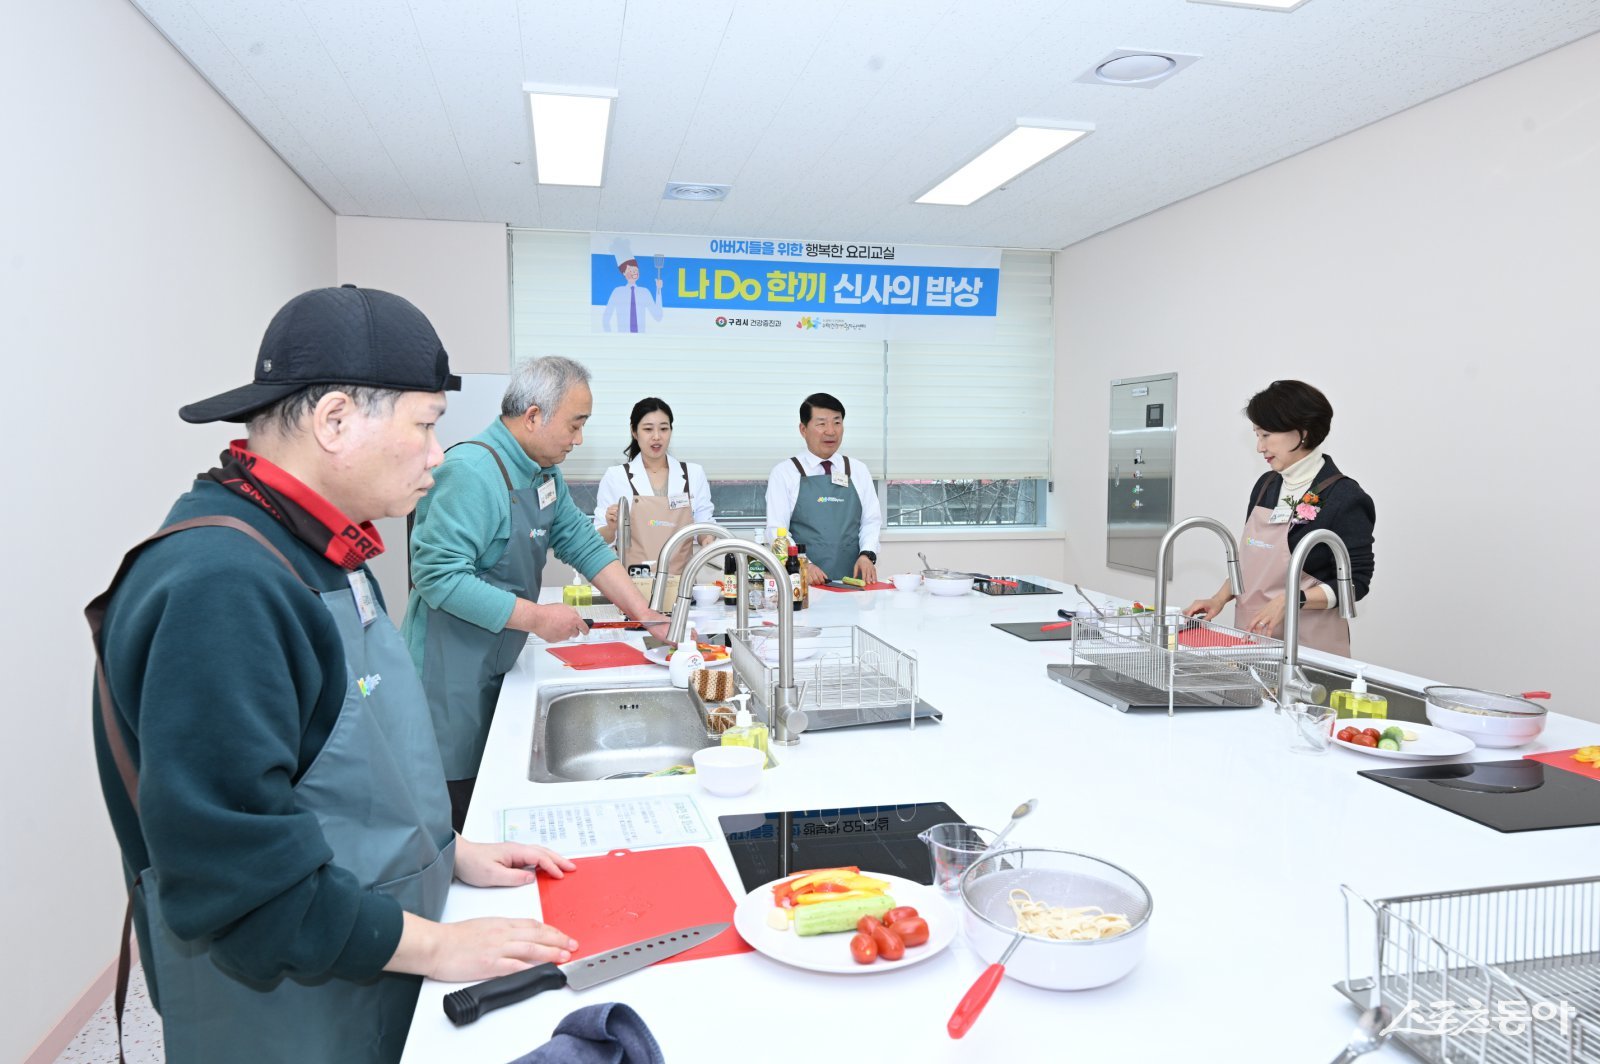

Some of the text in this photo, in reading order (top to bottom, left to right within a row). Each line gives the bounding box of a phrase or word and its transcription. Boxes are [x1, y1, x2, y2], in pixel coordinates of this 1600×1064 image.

[710, 239, 895, 260] 아버지들을 위한 행복한 요리교실
[678, 268, 983, 307] 나 Do 한끼 신사의 밥상
[728, 318, 749, 327] 구리시
